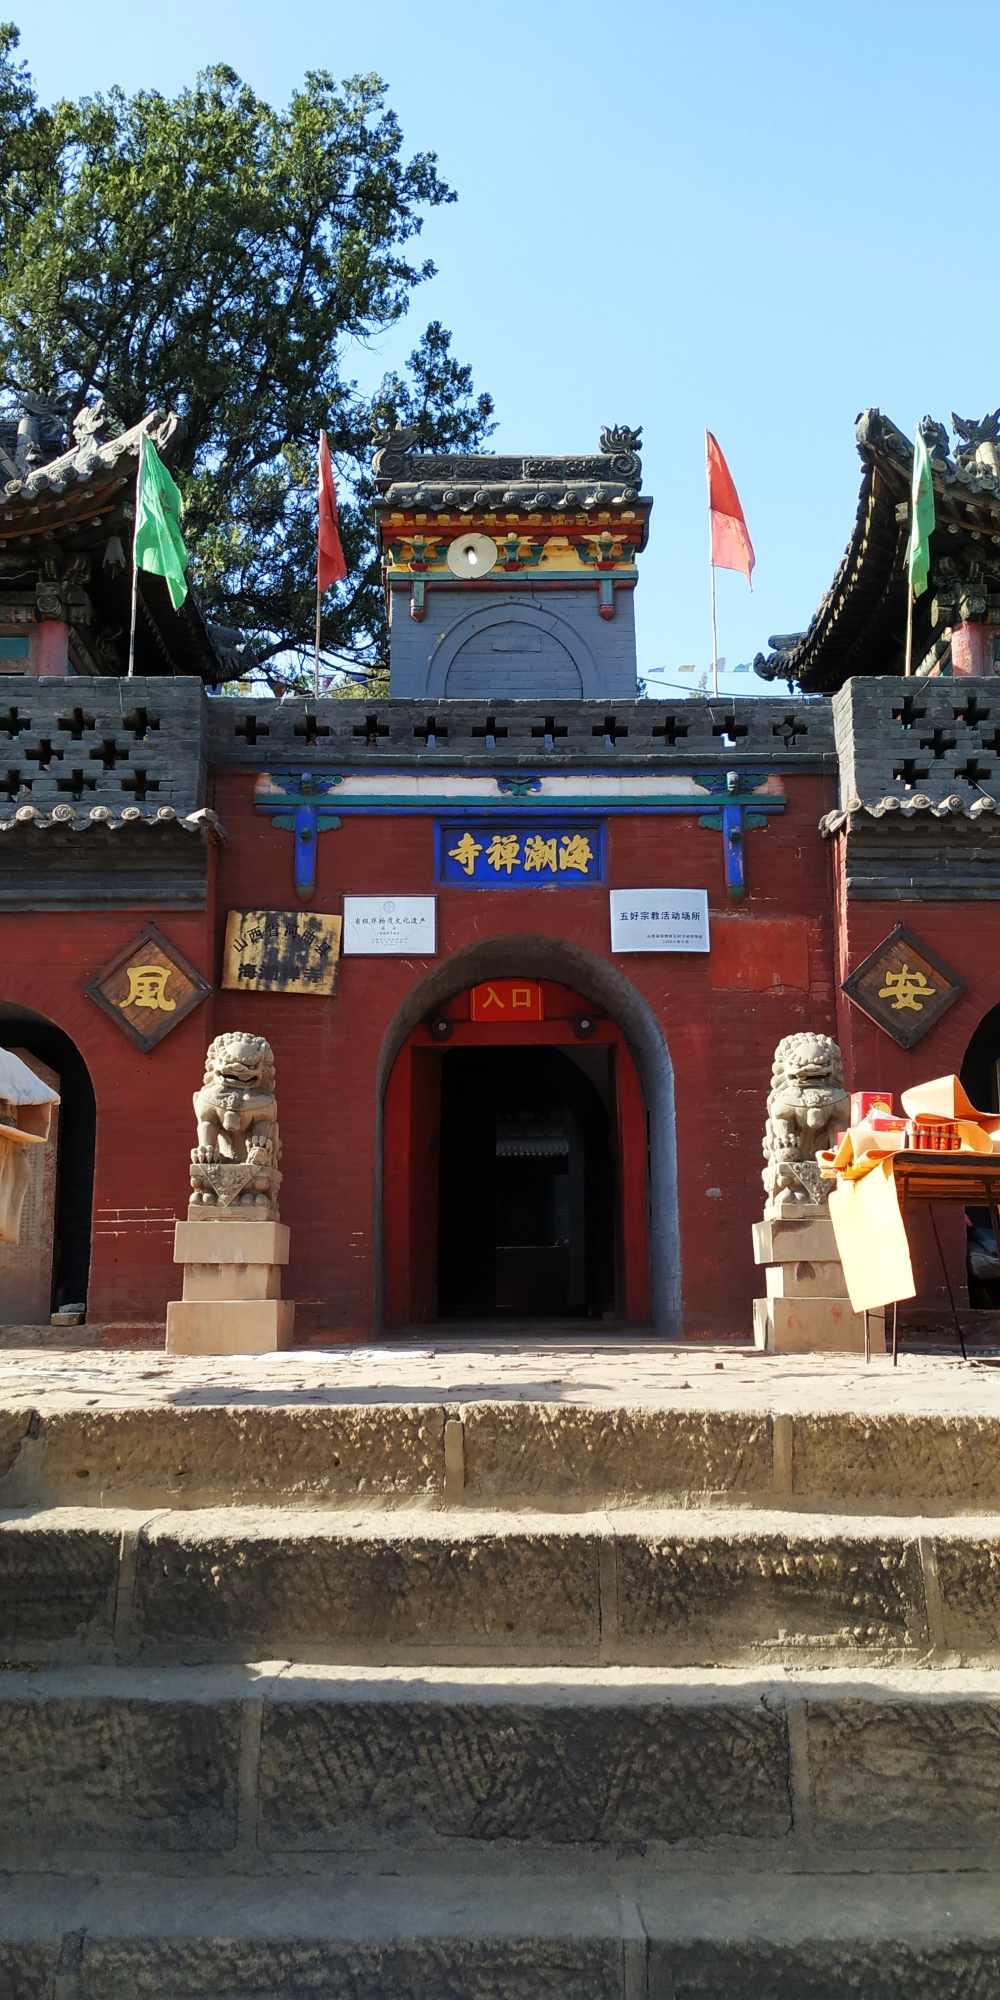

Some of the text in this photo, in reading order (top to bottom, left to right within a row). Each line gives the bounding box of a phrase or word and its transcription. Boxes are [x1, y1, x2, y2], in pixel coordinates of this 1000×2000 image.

[353, 916, 426, 925] 省级非物质文化遗产
[619, 911, 701, 921] 五好宗教活动场所
[232, 923, 331, 958] 山西省河曲县
[481, 986, 531, 1009] 入口
[878, 963, 936, 1011] 安
